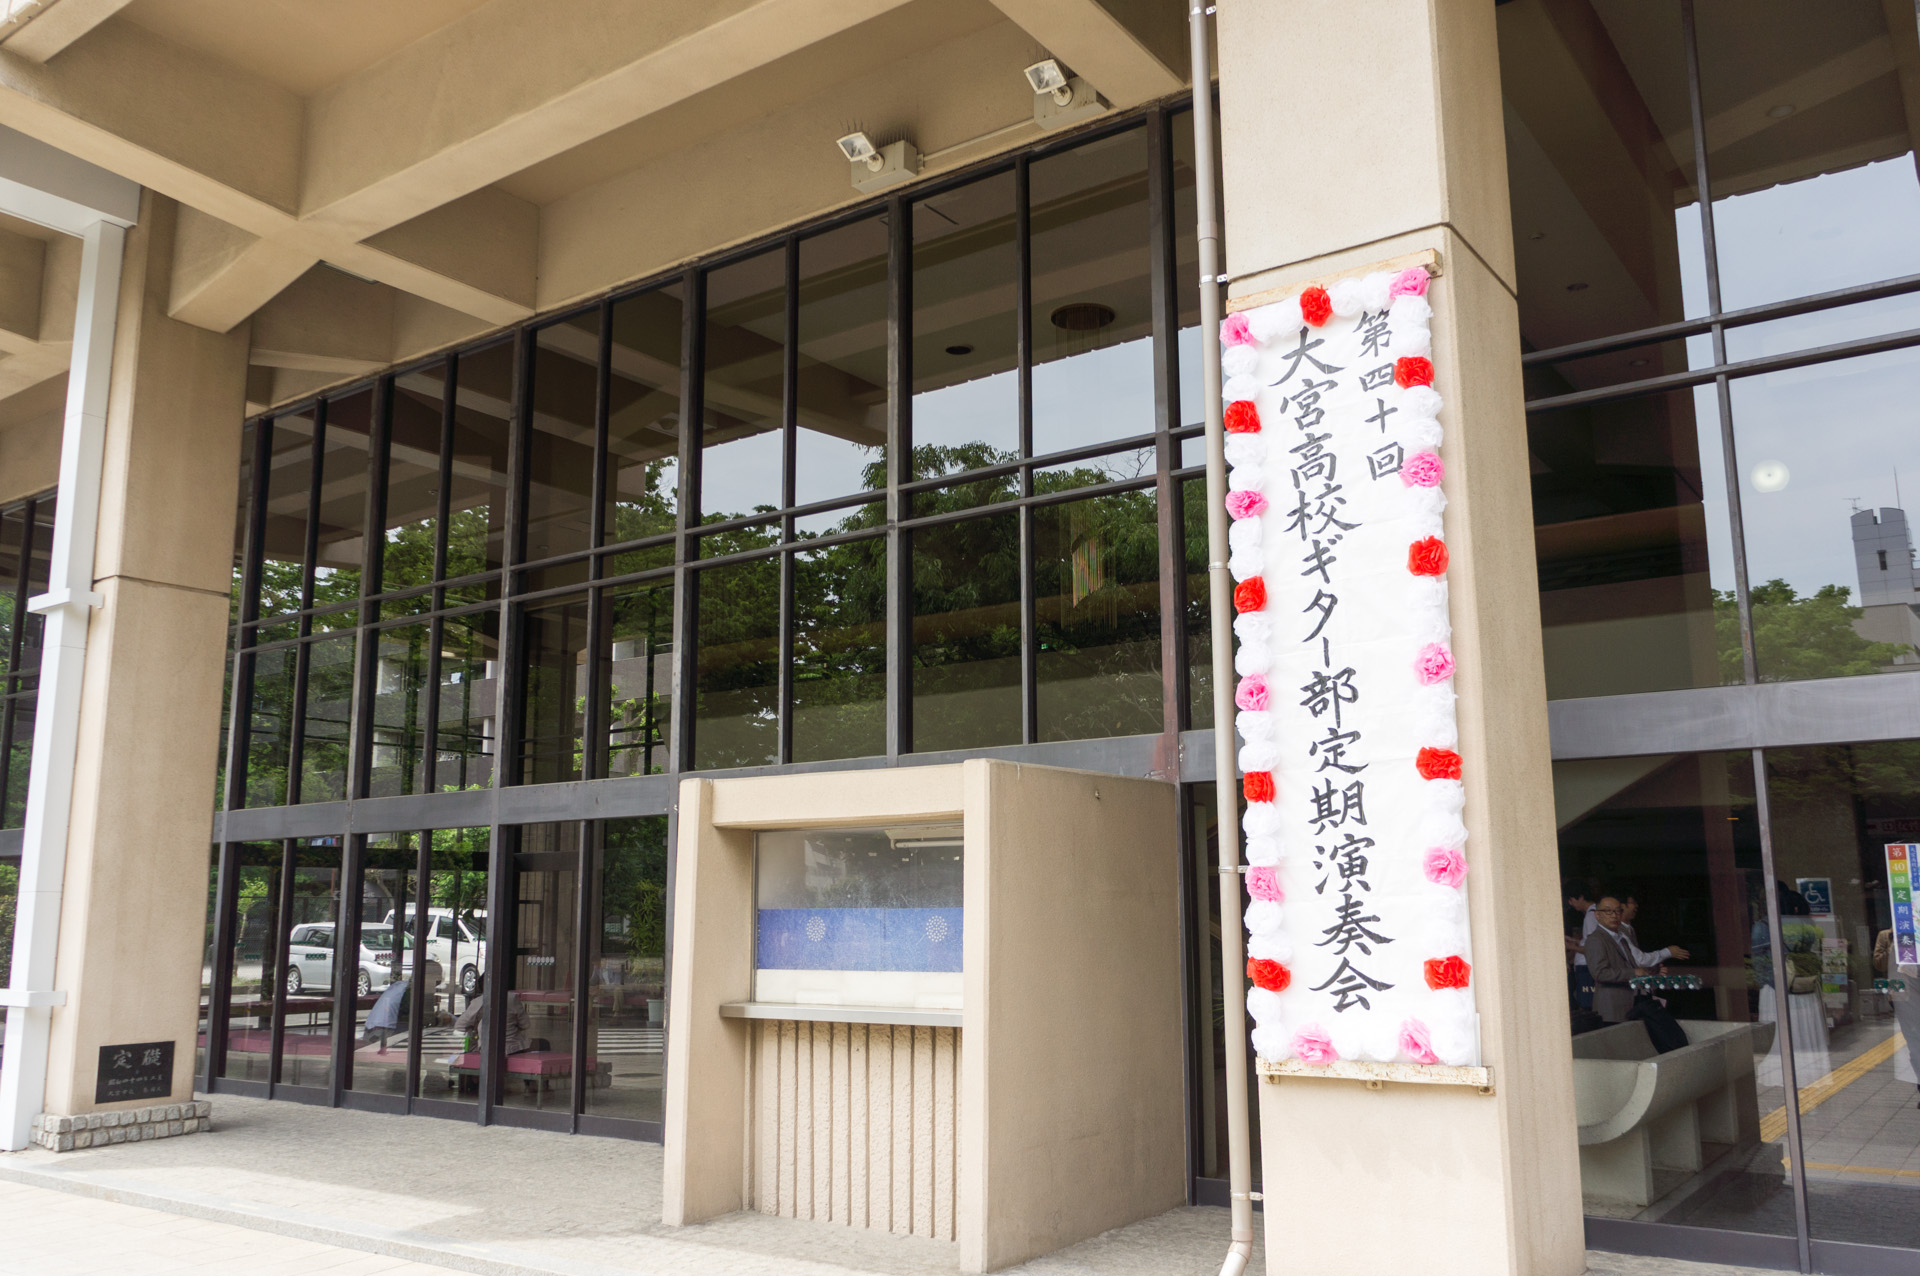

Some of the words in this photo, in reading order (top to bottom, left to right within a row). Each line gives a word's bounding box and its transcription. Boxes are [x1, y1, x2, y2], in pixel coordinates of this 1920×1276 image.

[1353, 309, 1405, 481] 第四十回
[1268, 326, 1396, 1012] 大宮高校ギター部定期演奏会
[113, 1048, 162, 1069] 定礎
